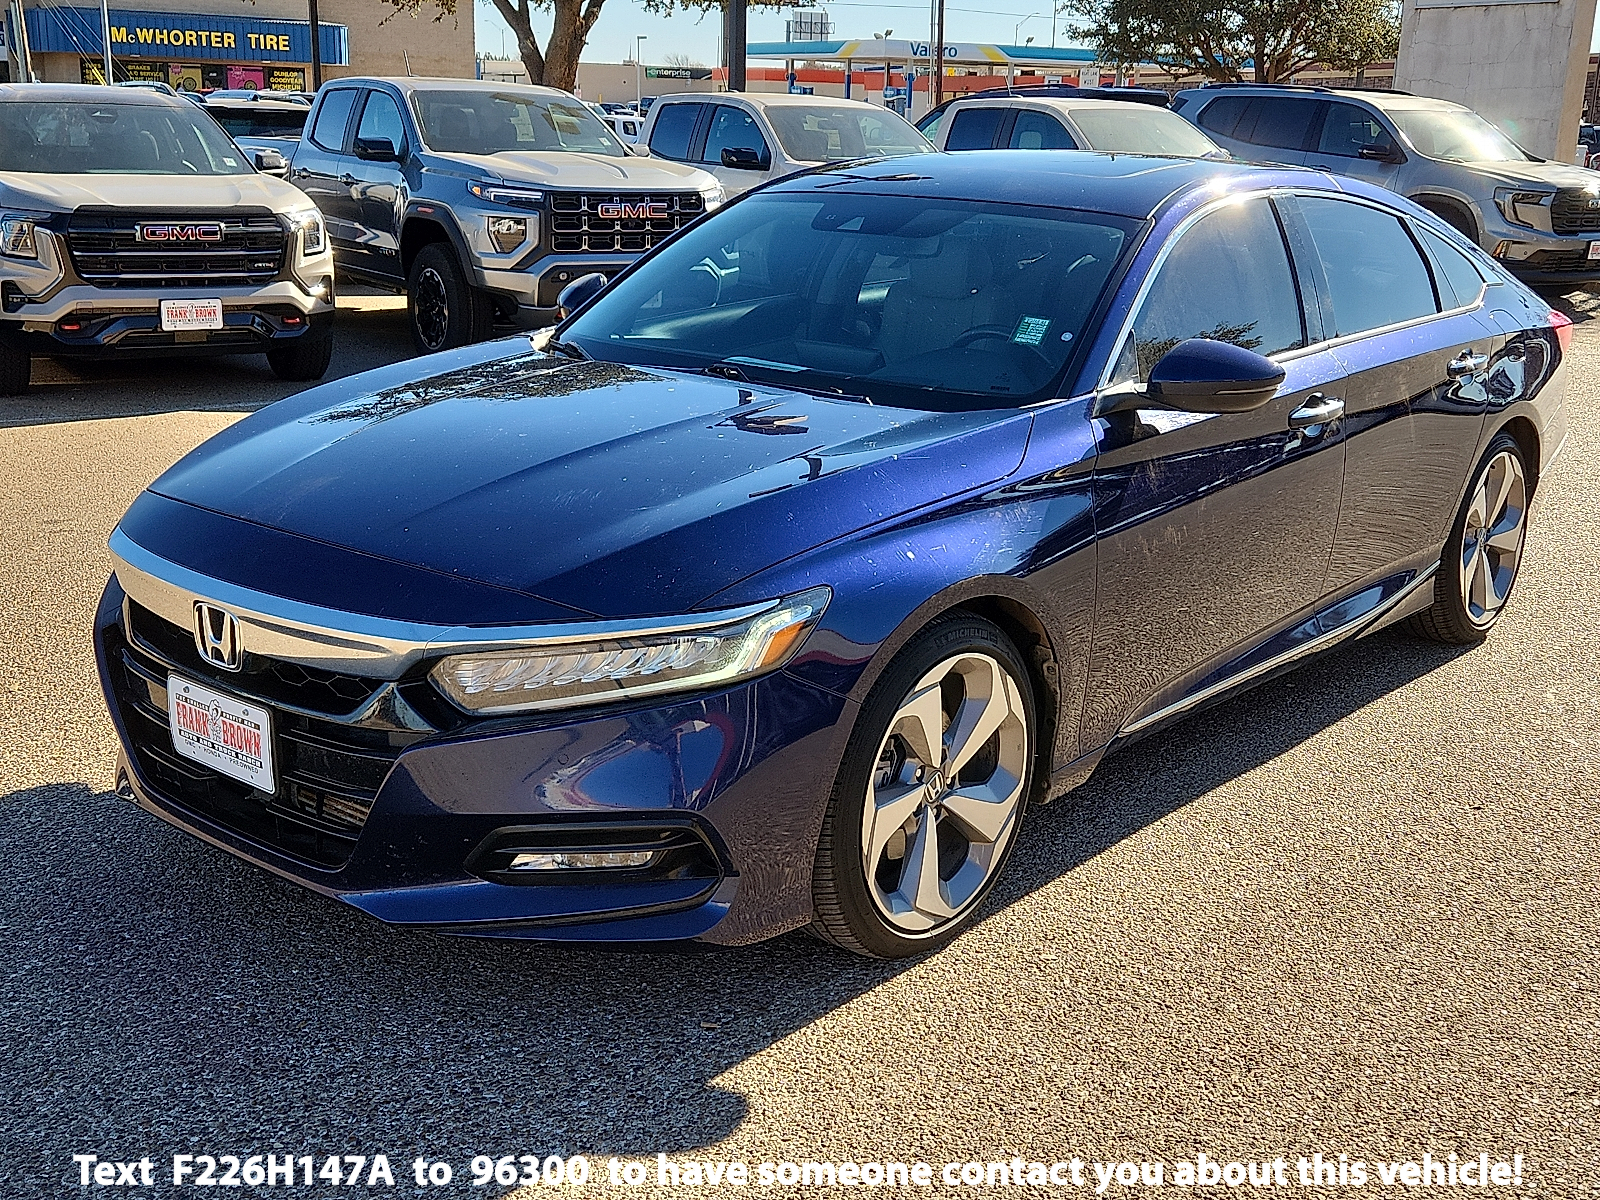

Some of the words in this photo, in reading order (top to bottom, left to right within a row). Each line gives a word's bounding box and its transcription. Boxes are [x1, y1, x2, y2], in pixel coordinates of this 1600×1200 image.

[111, 27, 235, 48] McWHORTER
[247, 34, 290, 50] TIRE
[650, 69, 691, 77] enterprise
[599, 203, 668, 219] GMC
[143, 225, 220, 241] GMC
[166, 309, 189, 319] FRANK
[195, 308, 217, 318] BROWN
[948, 628, 989, 641] MICHELIN
[176, 701, 210, 738] FRANK
[222, 720, 261, 759] BROWN
[180, 730, 198, 742] AUTO
[199, 737, 212, 748] AND
[213, 744, 236, 758] TRUCK
[238, 754, 261, 768] RANCH
